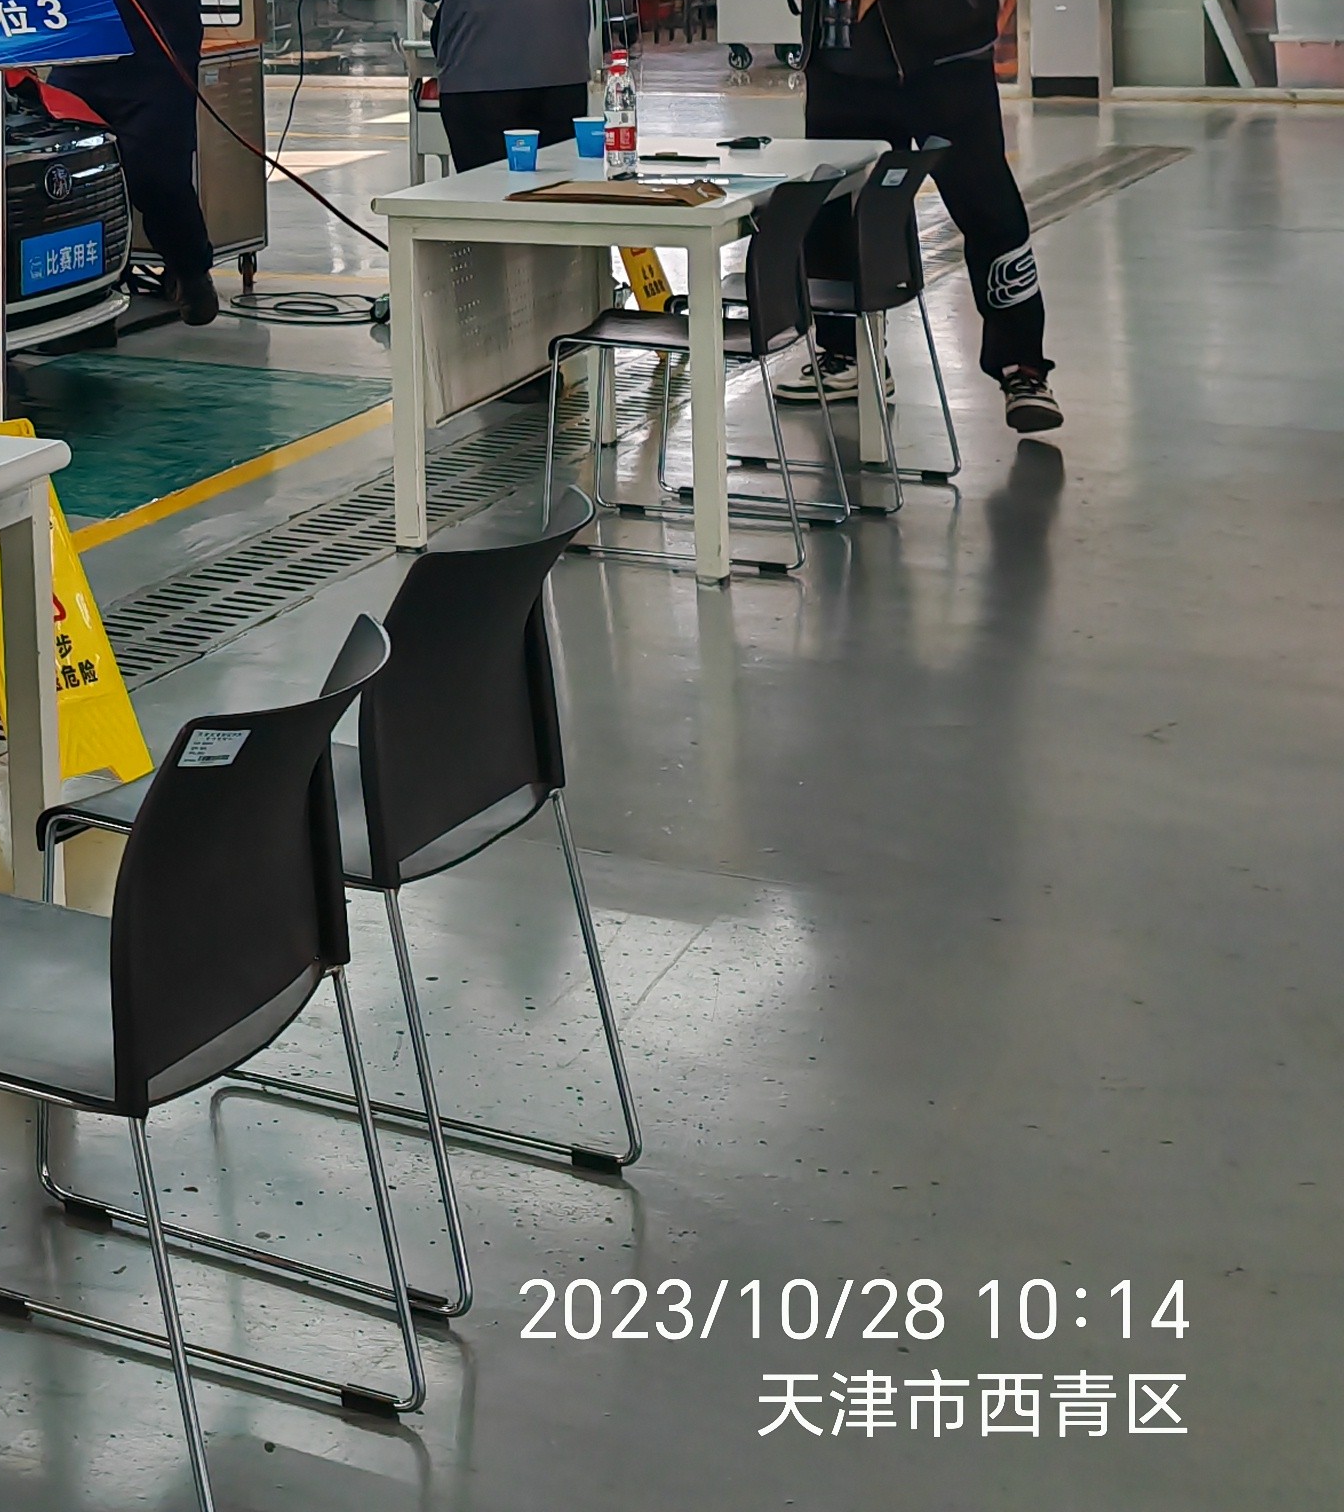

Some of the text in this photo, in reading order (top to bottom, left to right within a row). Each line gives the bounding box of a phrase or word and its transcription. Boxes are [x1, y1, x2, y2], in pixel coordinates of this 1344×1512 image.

[46, 239, 99, 277] 比赛用车
[55, 659, 99, 692] 危险
